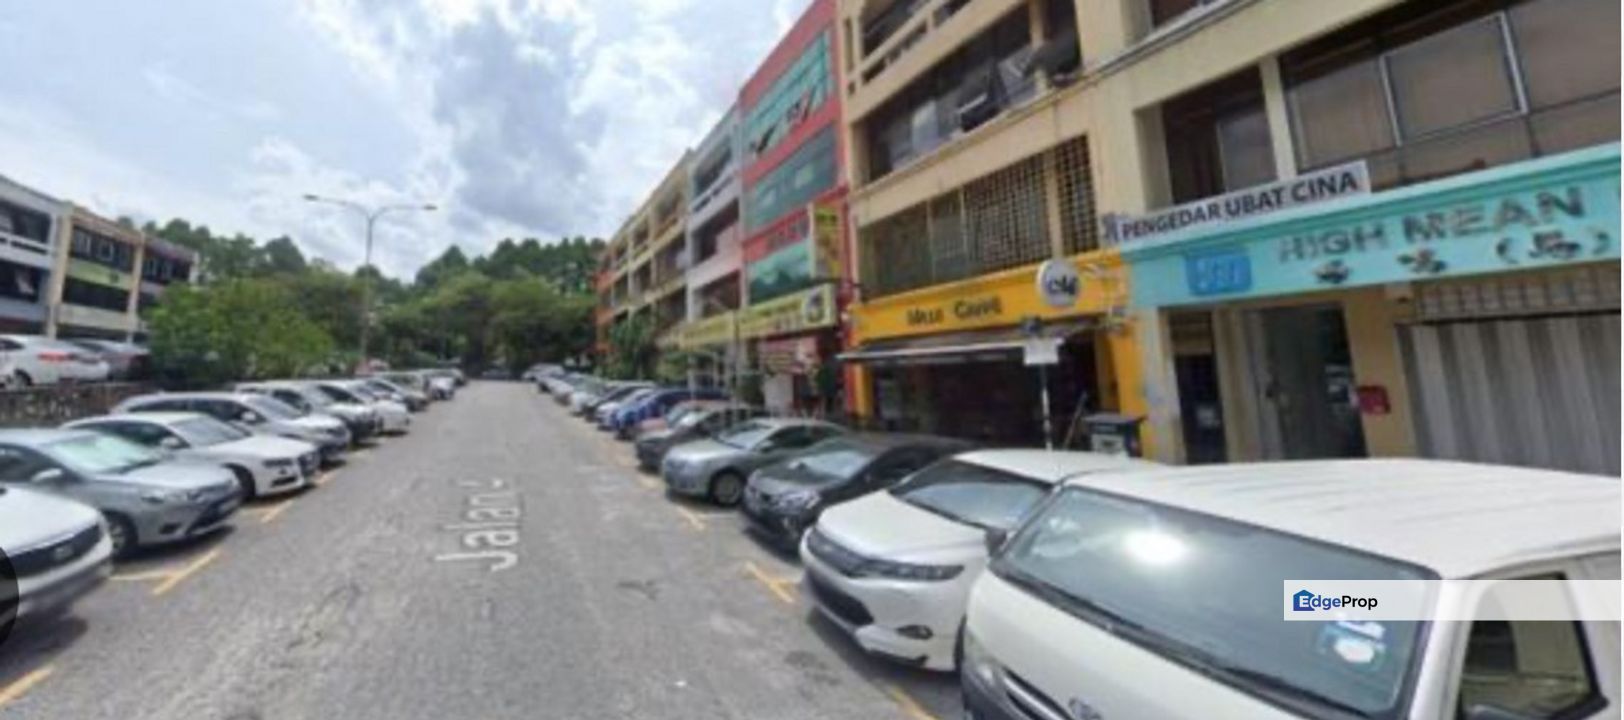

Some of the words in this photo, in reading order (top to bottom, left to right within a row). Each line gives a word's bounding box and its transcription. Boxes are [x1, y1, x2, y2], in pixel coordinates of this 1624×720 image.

[1122, 201, 1221, 240] PENGEDAR
[1224, 188, 1286, 218] UBAT
[1290, 171, 1359, 203] CINA
[1278, 222, 1385, 264] HIGH
[1403, 186, 1585, 243] MEAN
